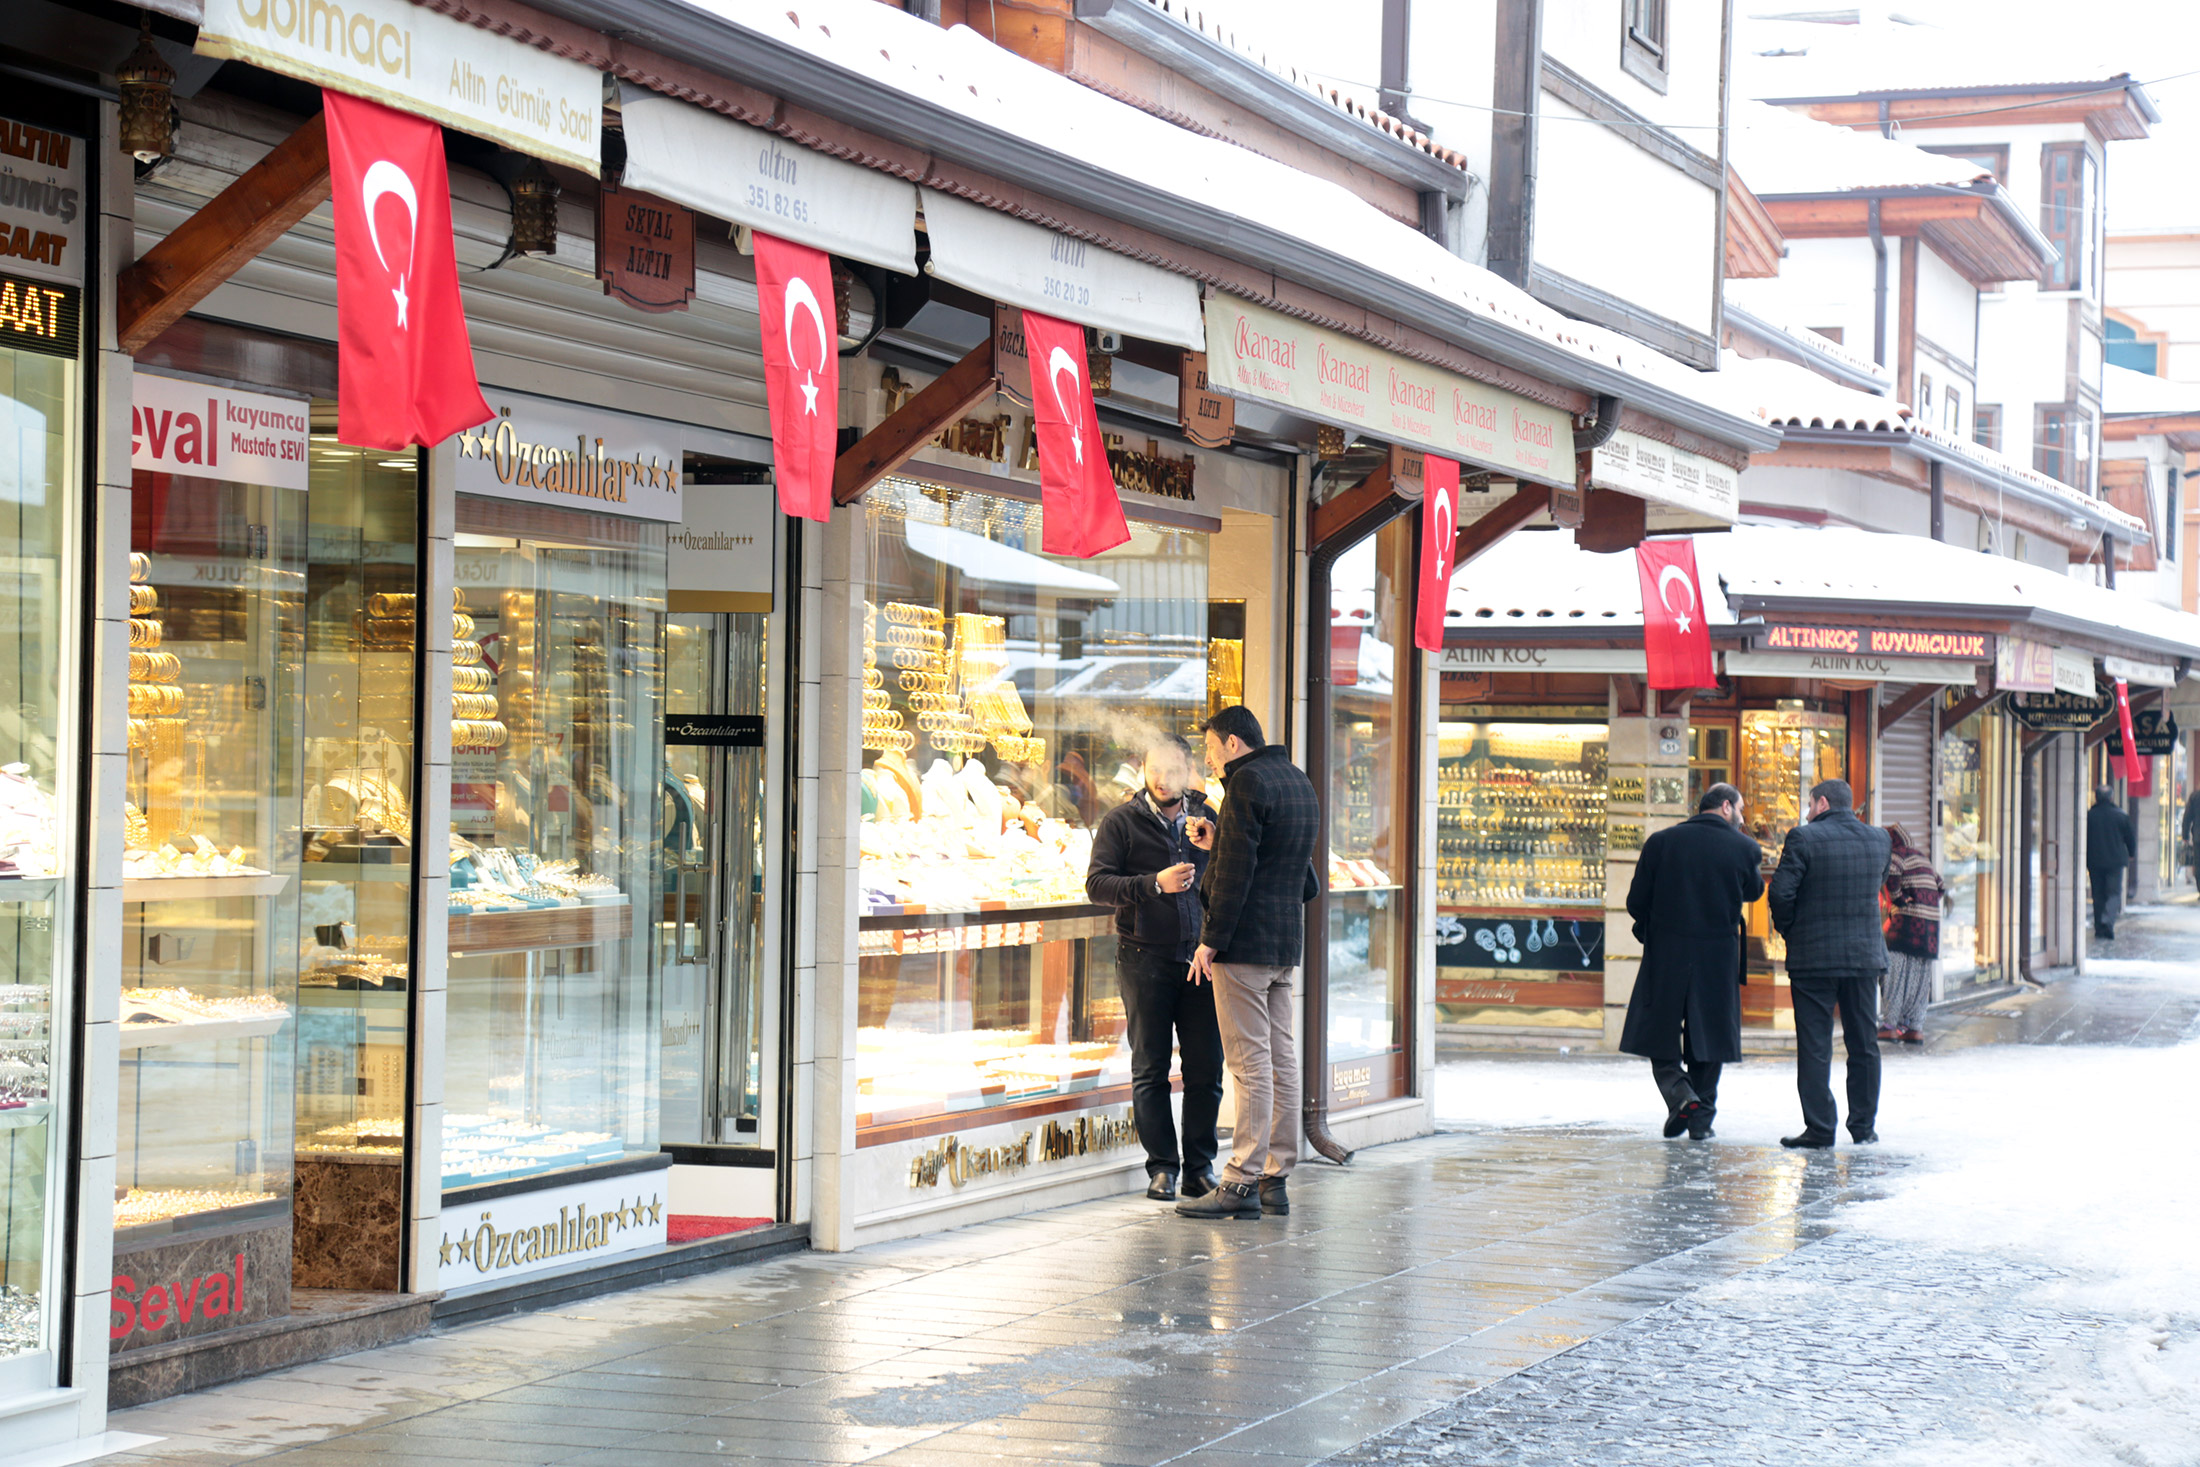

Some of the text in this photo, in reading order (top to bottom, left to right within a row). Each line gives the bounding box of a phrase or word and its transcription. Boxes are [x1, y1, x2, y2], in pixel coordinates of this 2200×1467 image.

[449, 58, 593, 145] Altın Gümüş Saat
[759, 140, 797, 186] altın
[625, 203, 673, 240] SEVAL
[748, 184, 808, 223] 351 82 65
[626, 245, 672, 281] ALTIN
[1043, 276, 1089, 306] 350 20 30
[1235, 315, 1296, 370] Kanaat
[1252, 369, 1258, 386] &
[1317, 343, 1370, 394] Kanaat
[1198, 397, 1222, 420] ALTIN
[1388, 367, 1436, 414] Kanaat
[226, 399, 305, 433] kuyumcu
[1453, 388, 1497, 432] Kanaat
[1512, 407, 1553, 449] Kanaat
[231, 431, 276, 458] Mustafa
[494, 406, 632, 503] Özcanlılar
[1402, 457, 1422, 479] ALTIN
[683, 527, 734, 551] Özcanlılar
[1503, 648, 1547, 667] KOÇ
[1768, 626, 1985, 656] ALTINKOÇ KUYUMCULUK
[680, 722, 741, 737] Özcanlılar
[474, 1202, 614, 1273] Özcanlılar
[109, 1253, 244, 1339] Seval
